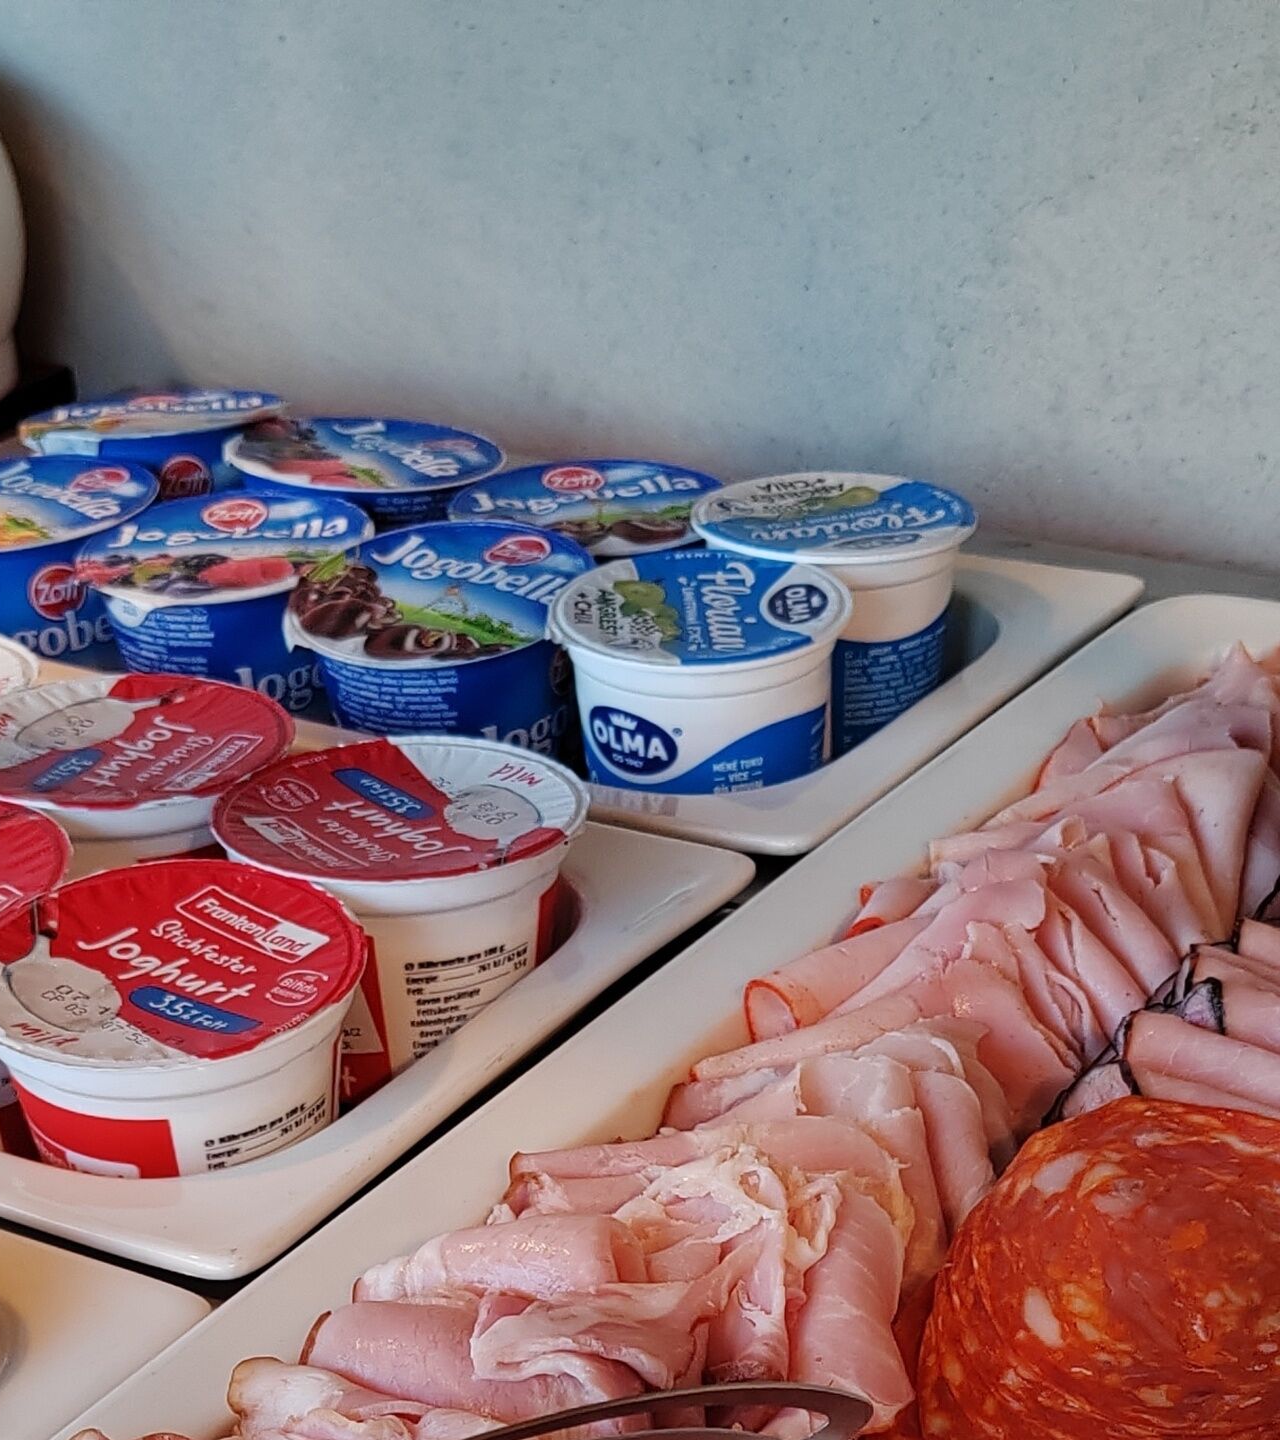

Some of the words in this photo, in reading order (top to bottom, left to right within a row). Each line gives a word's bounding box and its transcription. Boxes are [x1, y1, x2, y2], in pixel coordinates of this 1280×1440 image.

[107, 515, 348, 548] Jogobella
[208, 504, 261, 523] Zott
[36, 575, 85, 606] Zott
[696, 562, 758, 651] Florian
[785, 587, 812, 624] OLMA
[83, 716, 196, 787] Joghurt
[592, 718, 669, 762] OLMA
[323, 800, 471, 861] Joghurt
[76, 926, 260, 1005] Joghurt
[149, 919, 258, 977] Stichfester
[9, 1020, 80, 1047] Mild
[193, 1011, 230, 1032] Fett
